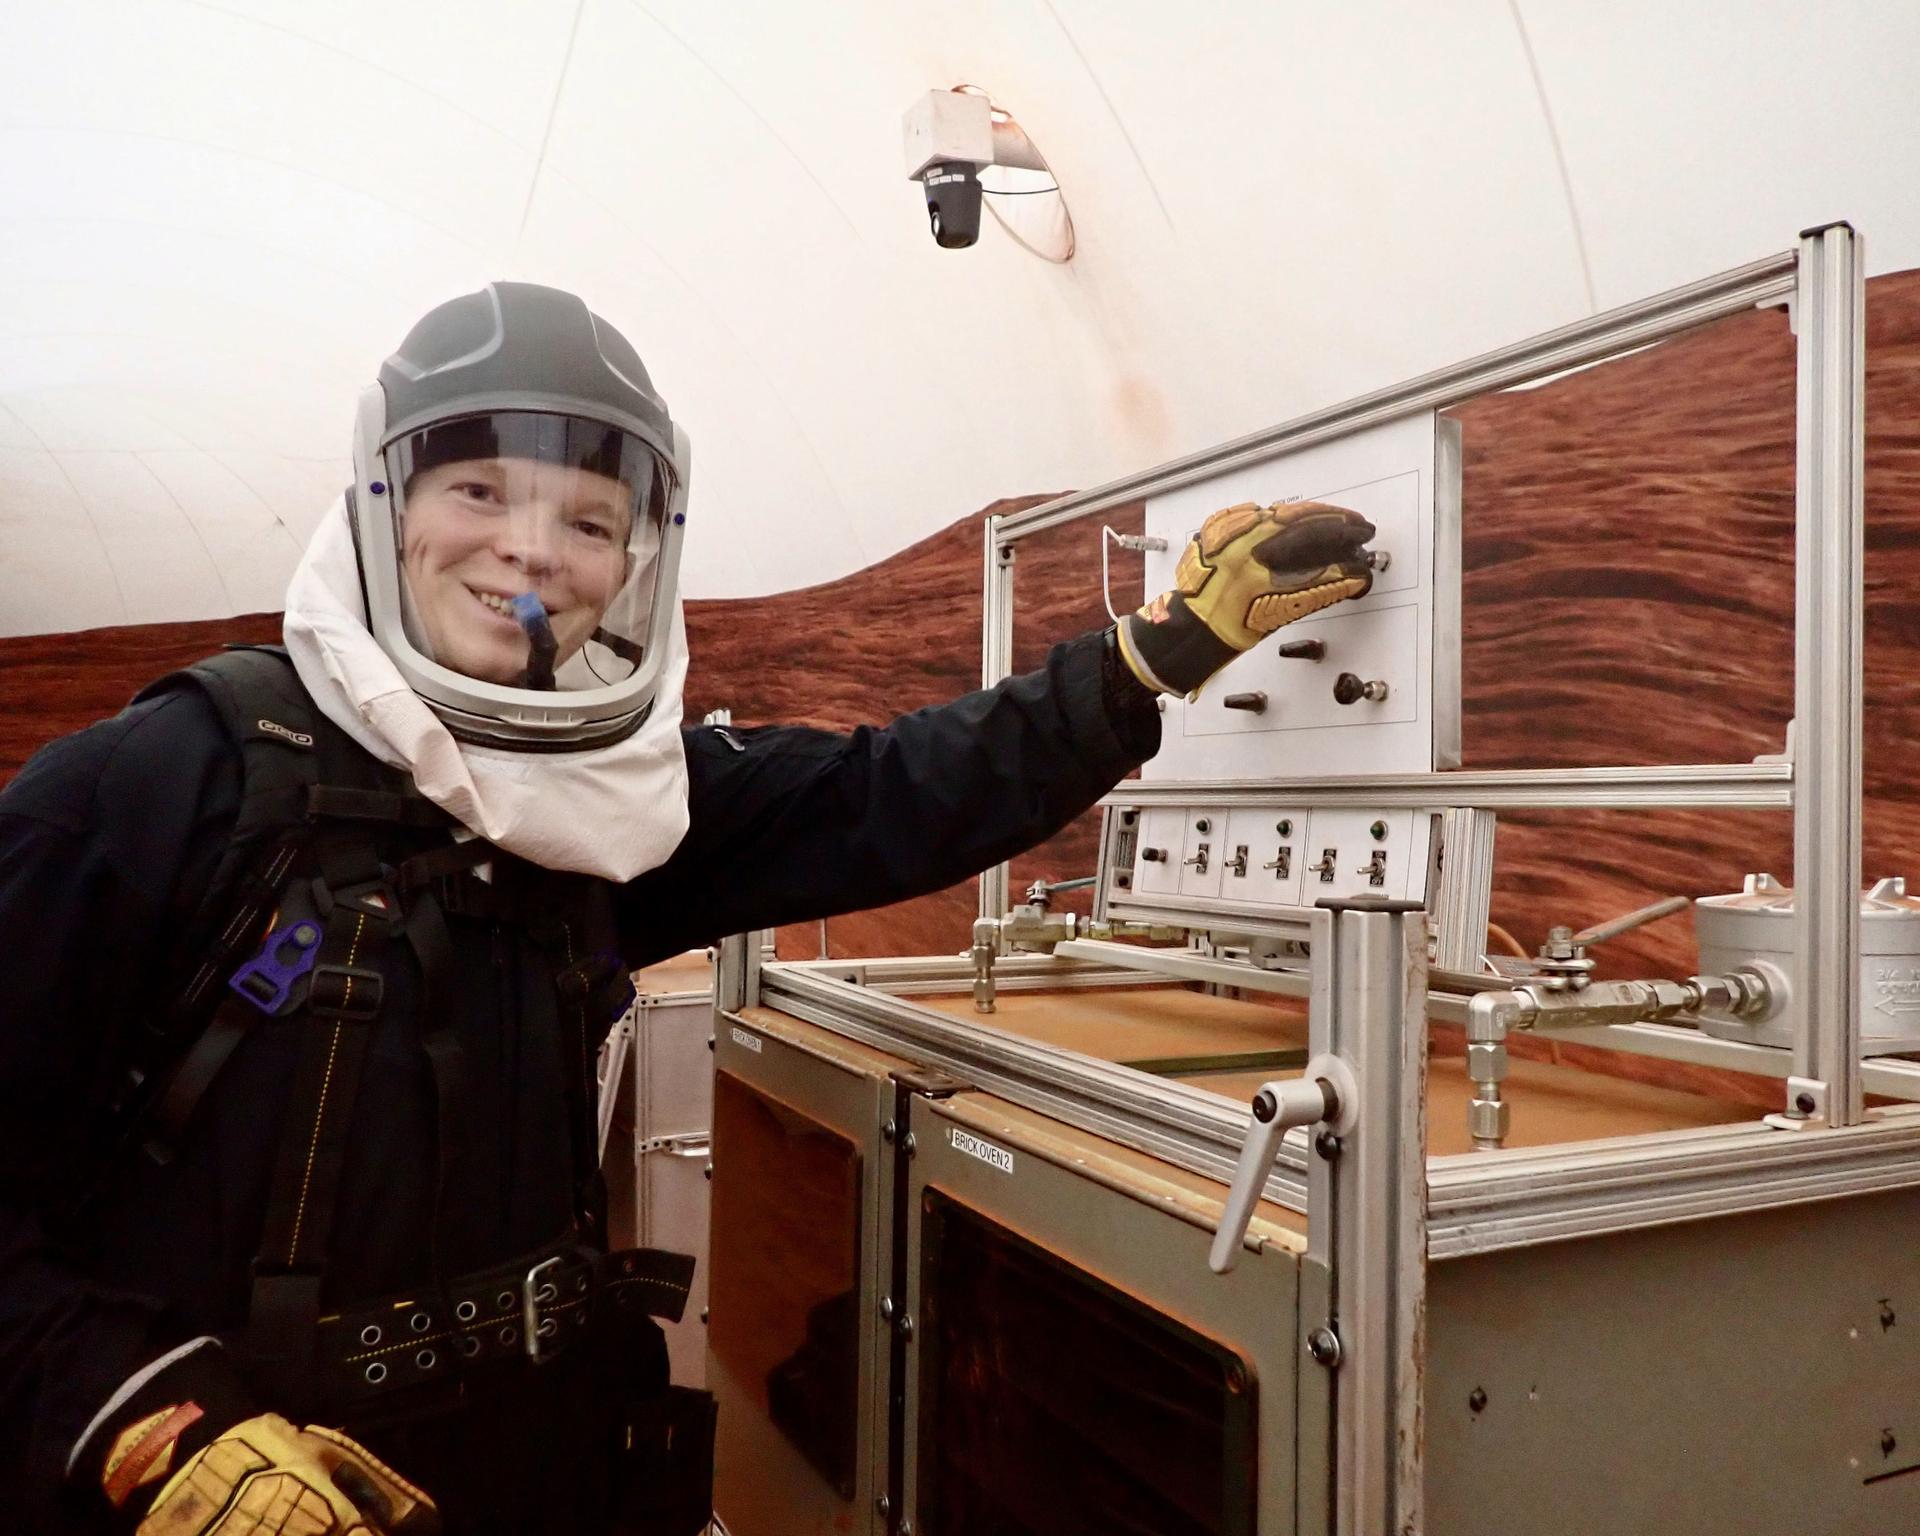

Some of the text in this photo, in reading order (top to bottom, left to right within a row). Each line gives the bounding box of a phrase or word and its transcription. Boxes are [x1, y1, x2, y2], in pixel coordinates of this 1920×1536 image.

[954, 1132, 1010, 1169] BRICK OVEN 2
